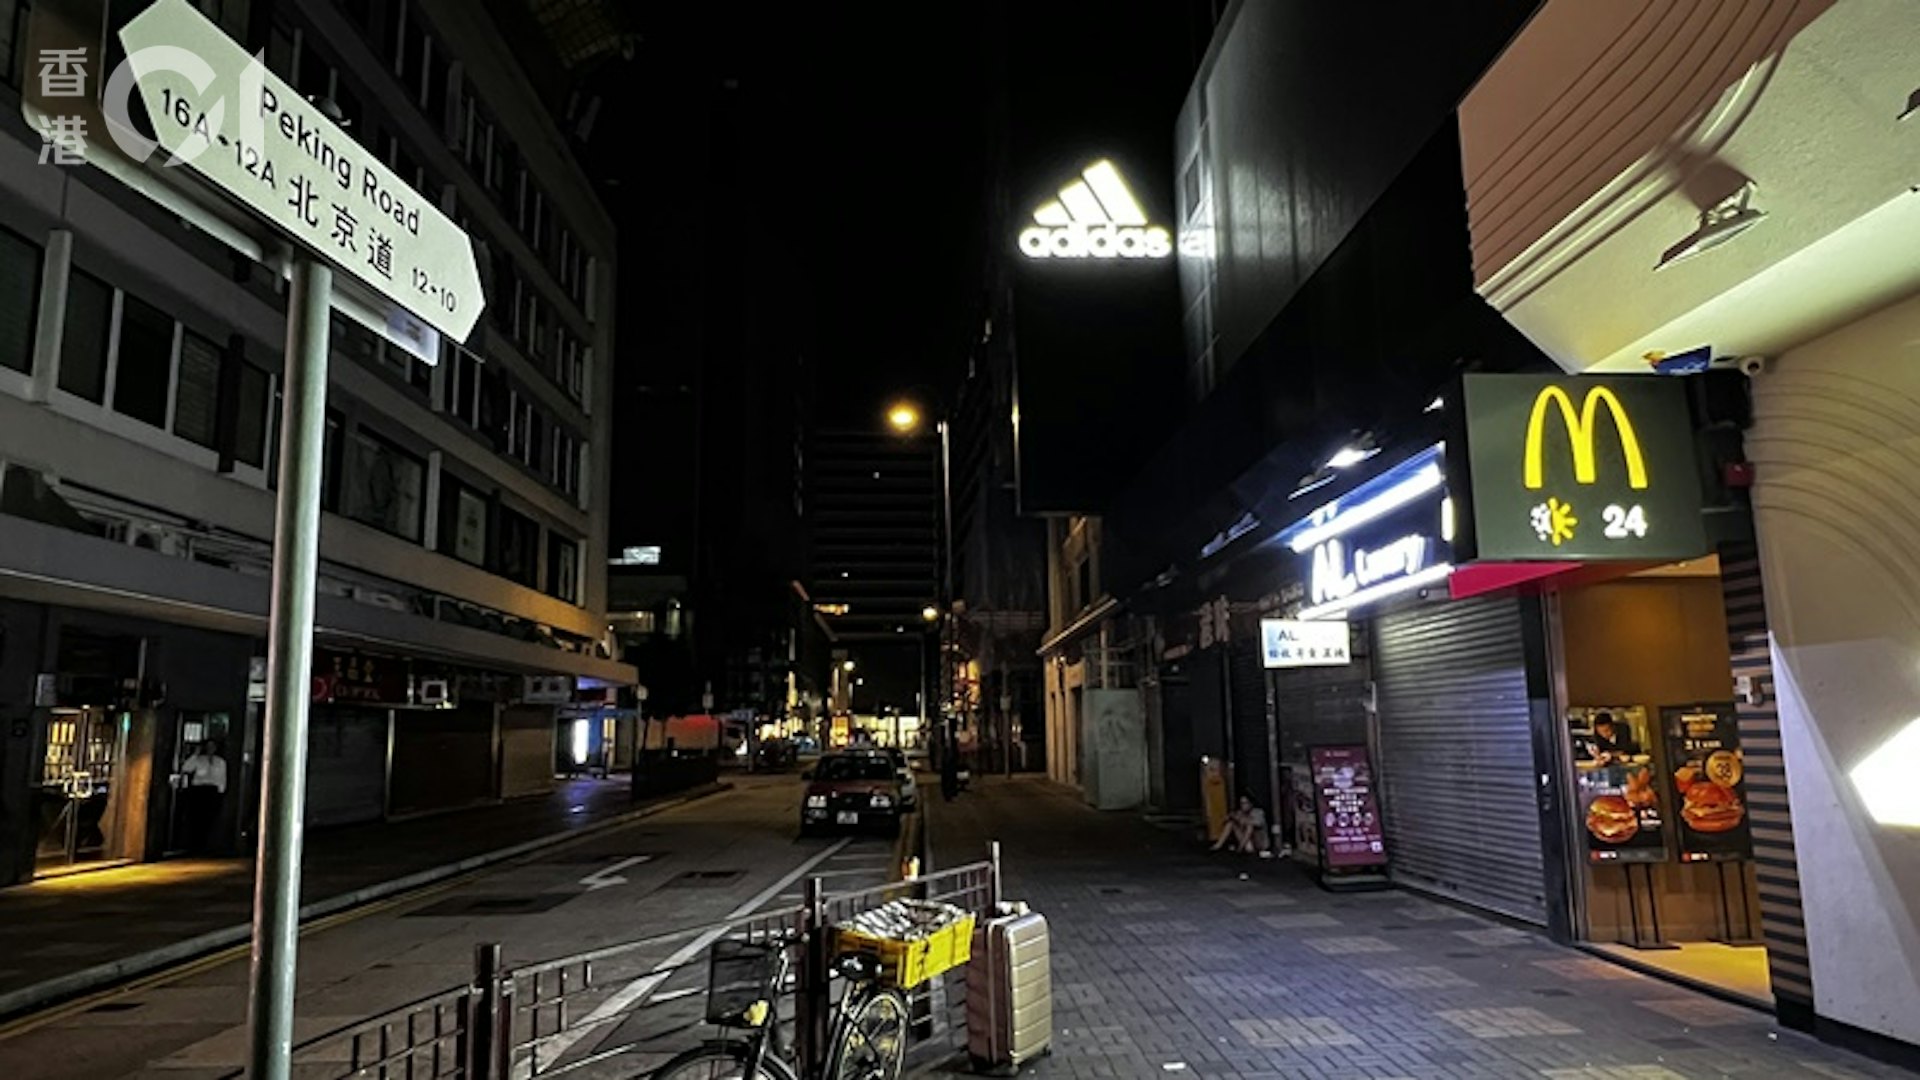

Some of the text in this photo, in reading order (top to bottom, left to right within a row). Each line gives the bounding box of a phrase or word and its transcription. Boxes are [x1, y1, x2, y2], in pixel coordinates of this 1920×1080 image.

[260, 85, 420, 236] Peking Road
[288, 174, 394, 281] 北京道
[1018, 222, 1172, 258] adidas
[1602, 503, 1648, 538] 24
